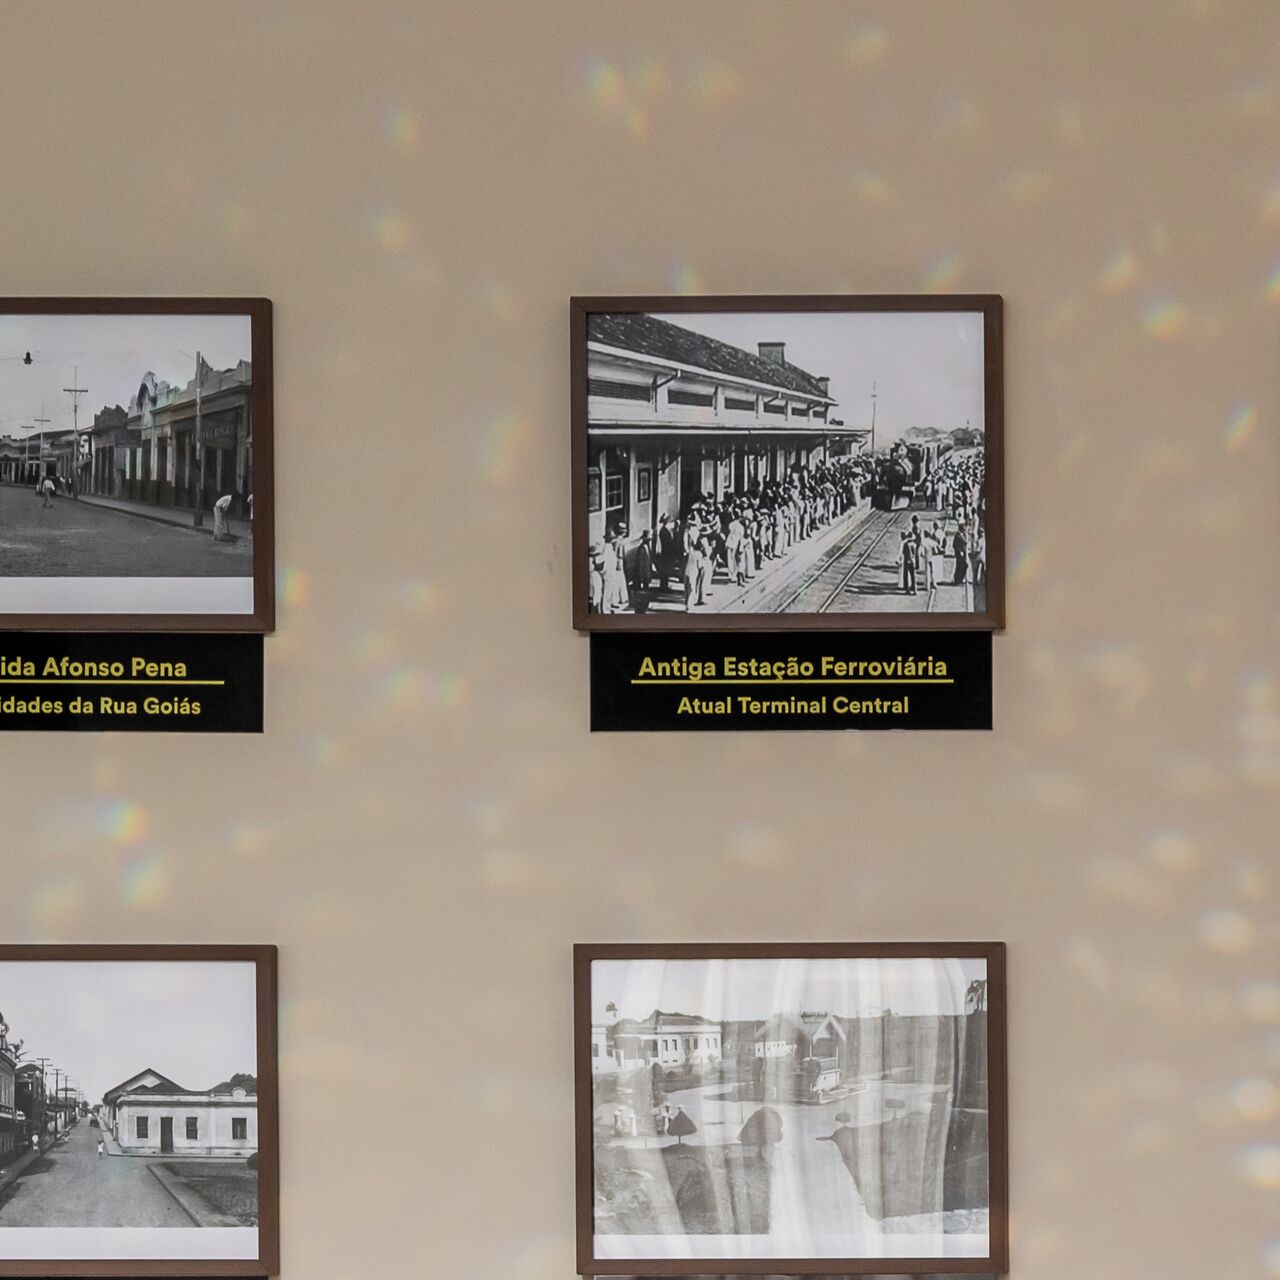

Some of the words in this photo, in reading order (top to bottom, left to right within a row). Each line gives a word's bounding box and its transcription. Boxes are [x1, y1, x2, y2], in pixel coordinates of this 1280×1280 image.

[42, 656, 125, 677] Afonso
[131, 657, 188, 678] Pena
[638, 656, 716, 680] Antiga
[723, 655, 814, 681] Estação
[821, 655, 947, 676] Ferroviária
[0, 696, 63, 714] dades
[68, 696, 93, 714] da
[100, 696, 137, 715] Rua
[143, 695, 201, 715] Goiás
[677, 696, 732, 714] Atual
[738, 696, 827, 714] Terminal
[832, 696, 909, 714] Central
